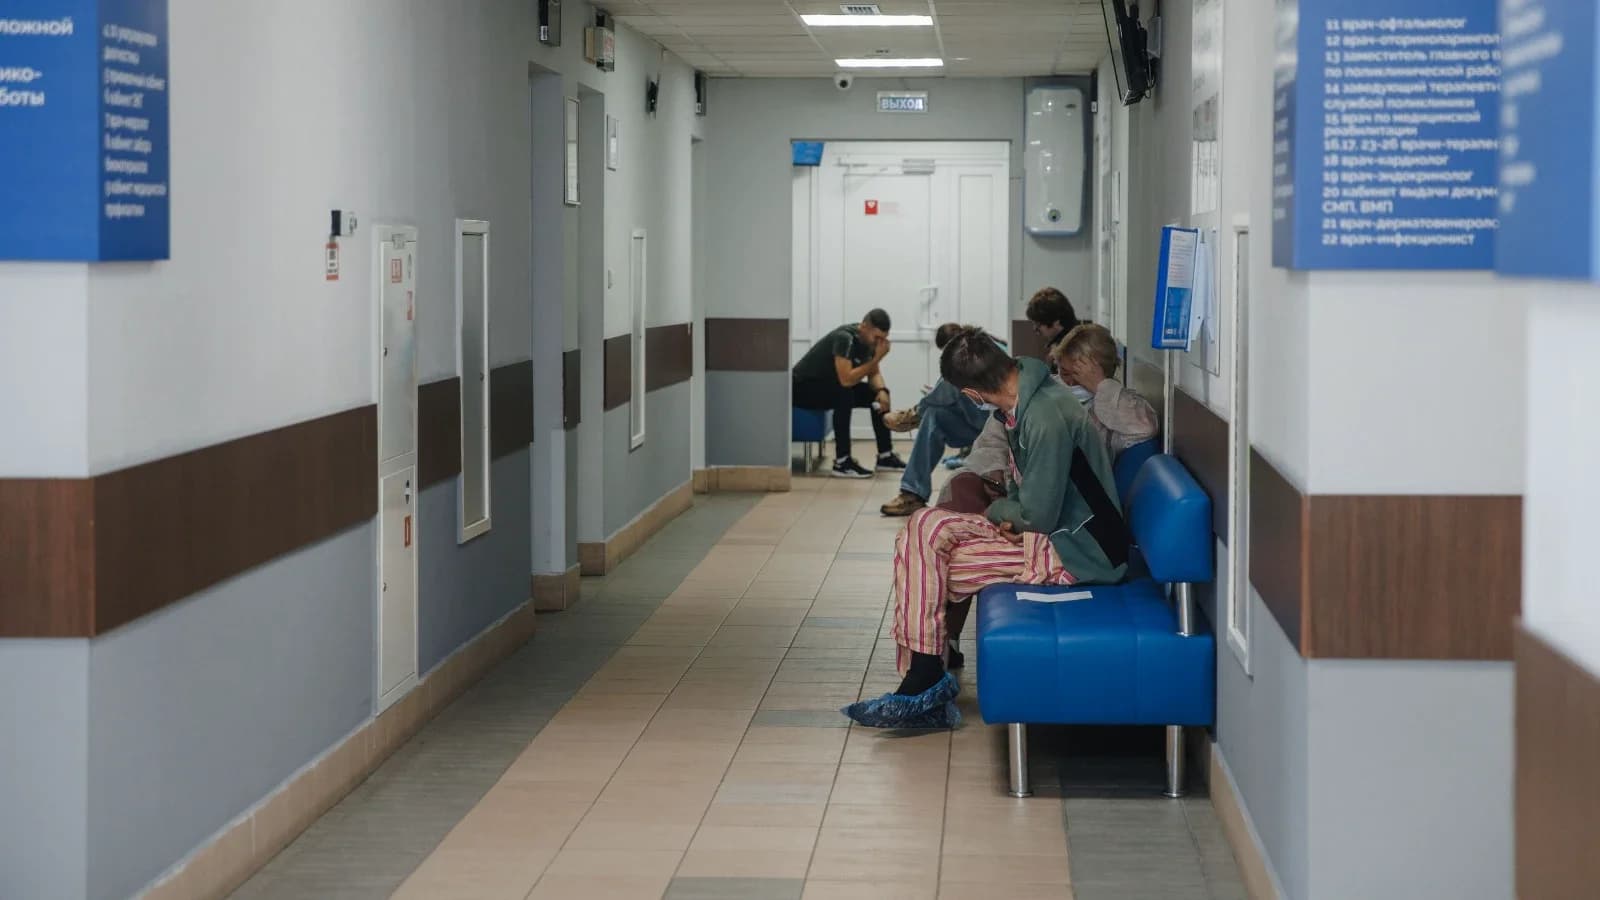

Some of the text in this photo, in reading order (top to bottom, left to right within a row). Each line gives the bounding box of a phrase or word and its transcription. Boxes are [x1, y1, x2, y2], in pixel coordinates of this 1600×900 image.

[0, 17, 73, 35] ложной
[1341, 18, 1466, 31] врач-офтальмолог
[1326, 34, 1501, 47] 12 врач-оториноларингол
[1325, 51, 1340, 63] 13
[1343, 51, 1427, 62] заместитель
[1429, 50, 1489, 60] главного
[1325, 67, 1342, 78] по
[1343, 65, 1464, 78] поликлинической
[1325, 83, 1340, 94] 14
[1342, 82, 1427, 95] заведующий
[882, 98, 923, 110] ВЫХОД
[1324, 97, 1475, 112] службой поликлиники
[1325, 112, 1480, 125] 15 врач по медицинской
[1324, 126, 1417, 138] реабилитации
[1361, 137, 1398, 152] 23-26
[1324, 154, 1448, 168] 18 врач-кардиолог
[1323, 171, 1472, 184] 19 врач-эндокринолог
[1323, 187, 1340, 198] 20
[1341, 185, 1396, 197] кабинет
[1399, 187, 1449, 198] выдачи
[1360, 200, 1393, 213] ВМП
[1323, 218, 1337, 229] 21
[1322, 233, 1474, 247] 22 врач-инфекционист
